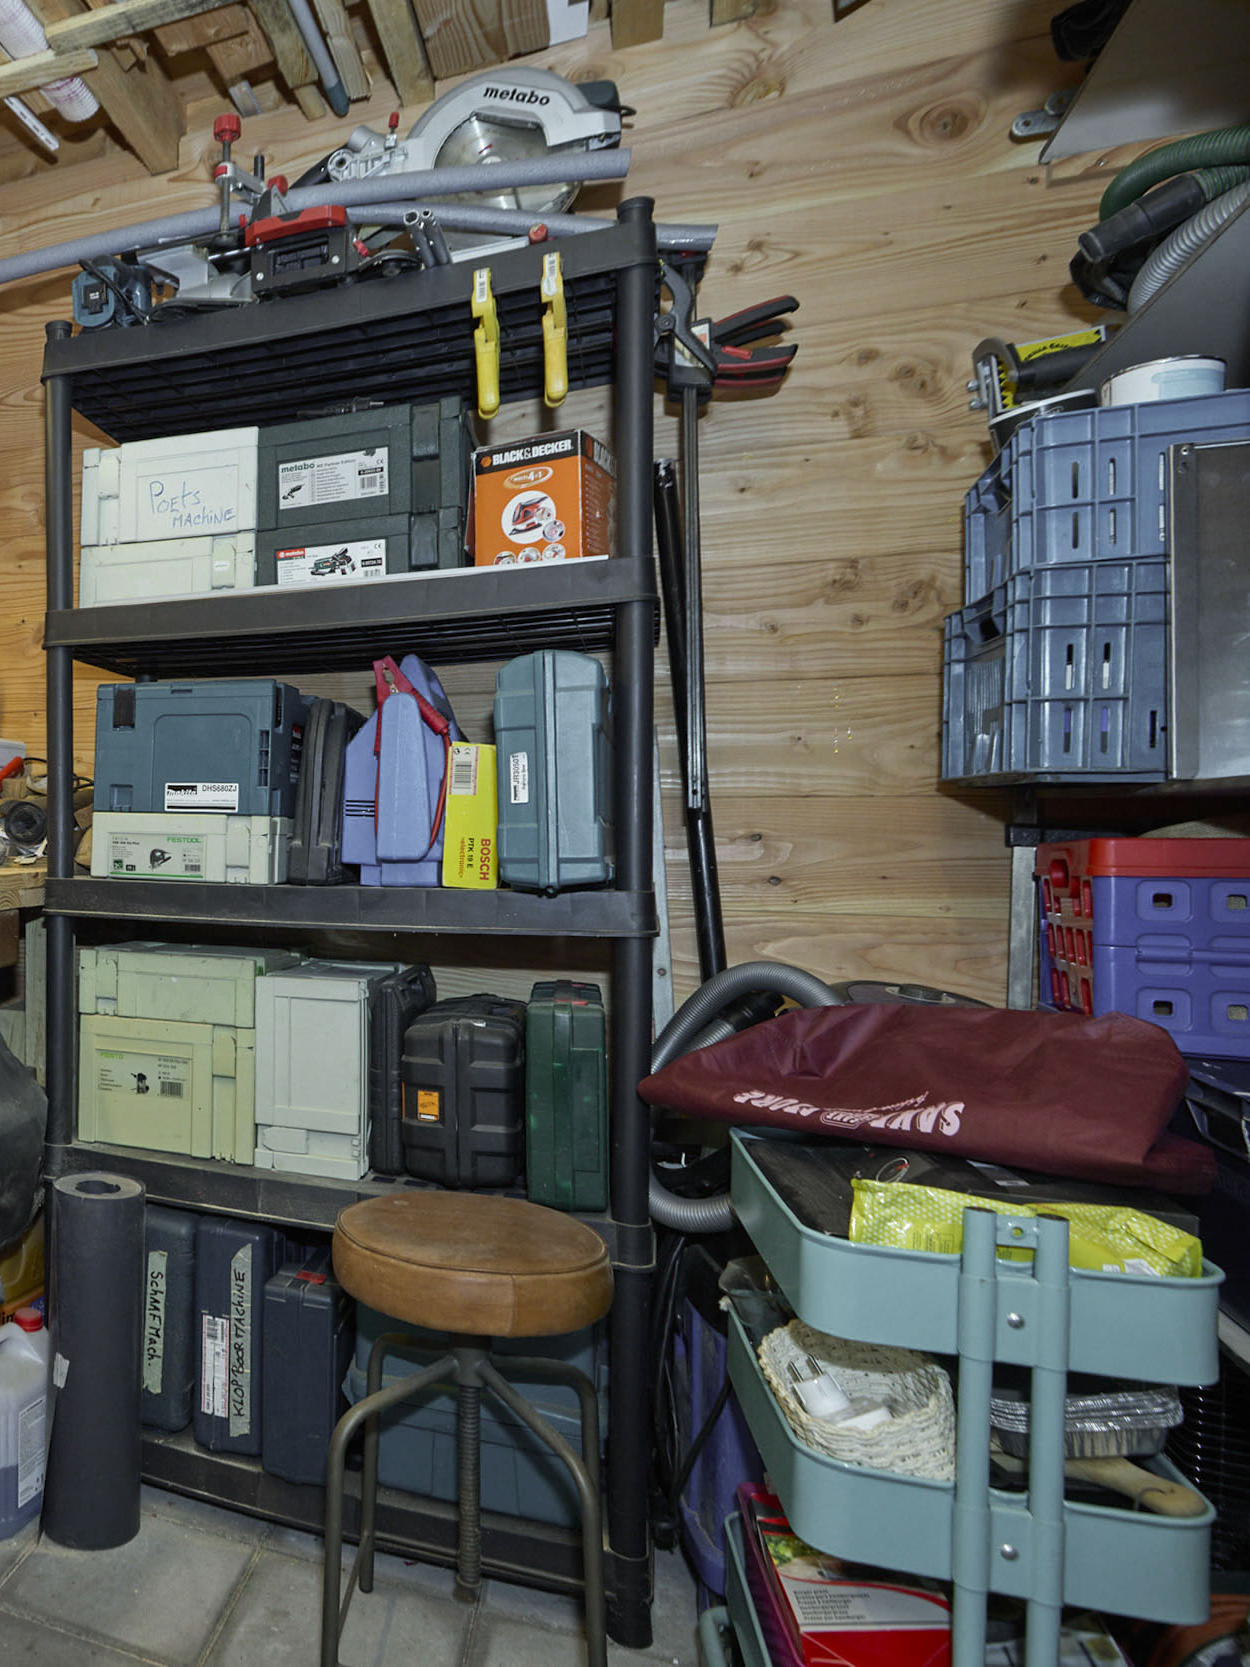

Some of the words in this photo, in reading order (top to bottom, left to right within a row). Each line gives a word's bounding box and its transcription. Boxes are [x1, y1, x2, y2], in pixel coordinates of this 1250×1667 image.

[483, 87, 550, 106] metabo
[281, 463, 315, 473] metabo
[480, 838, 491, 881] BOSCH
[231, 1379, 245, 1417] KLOP
